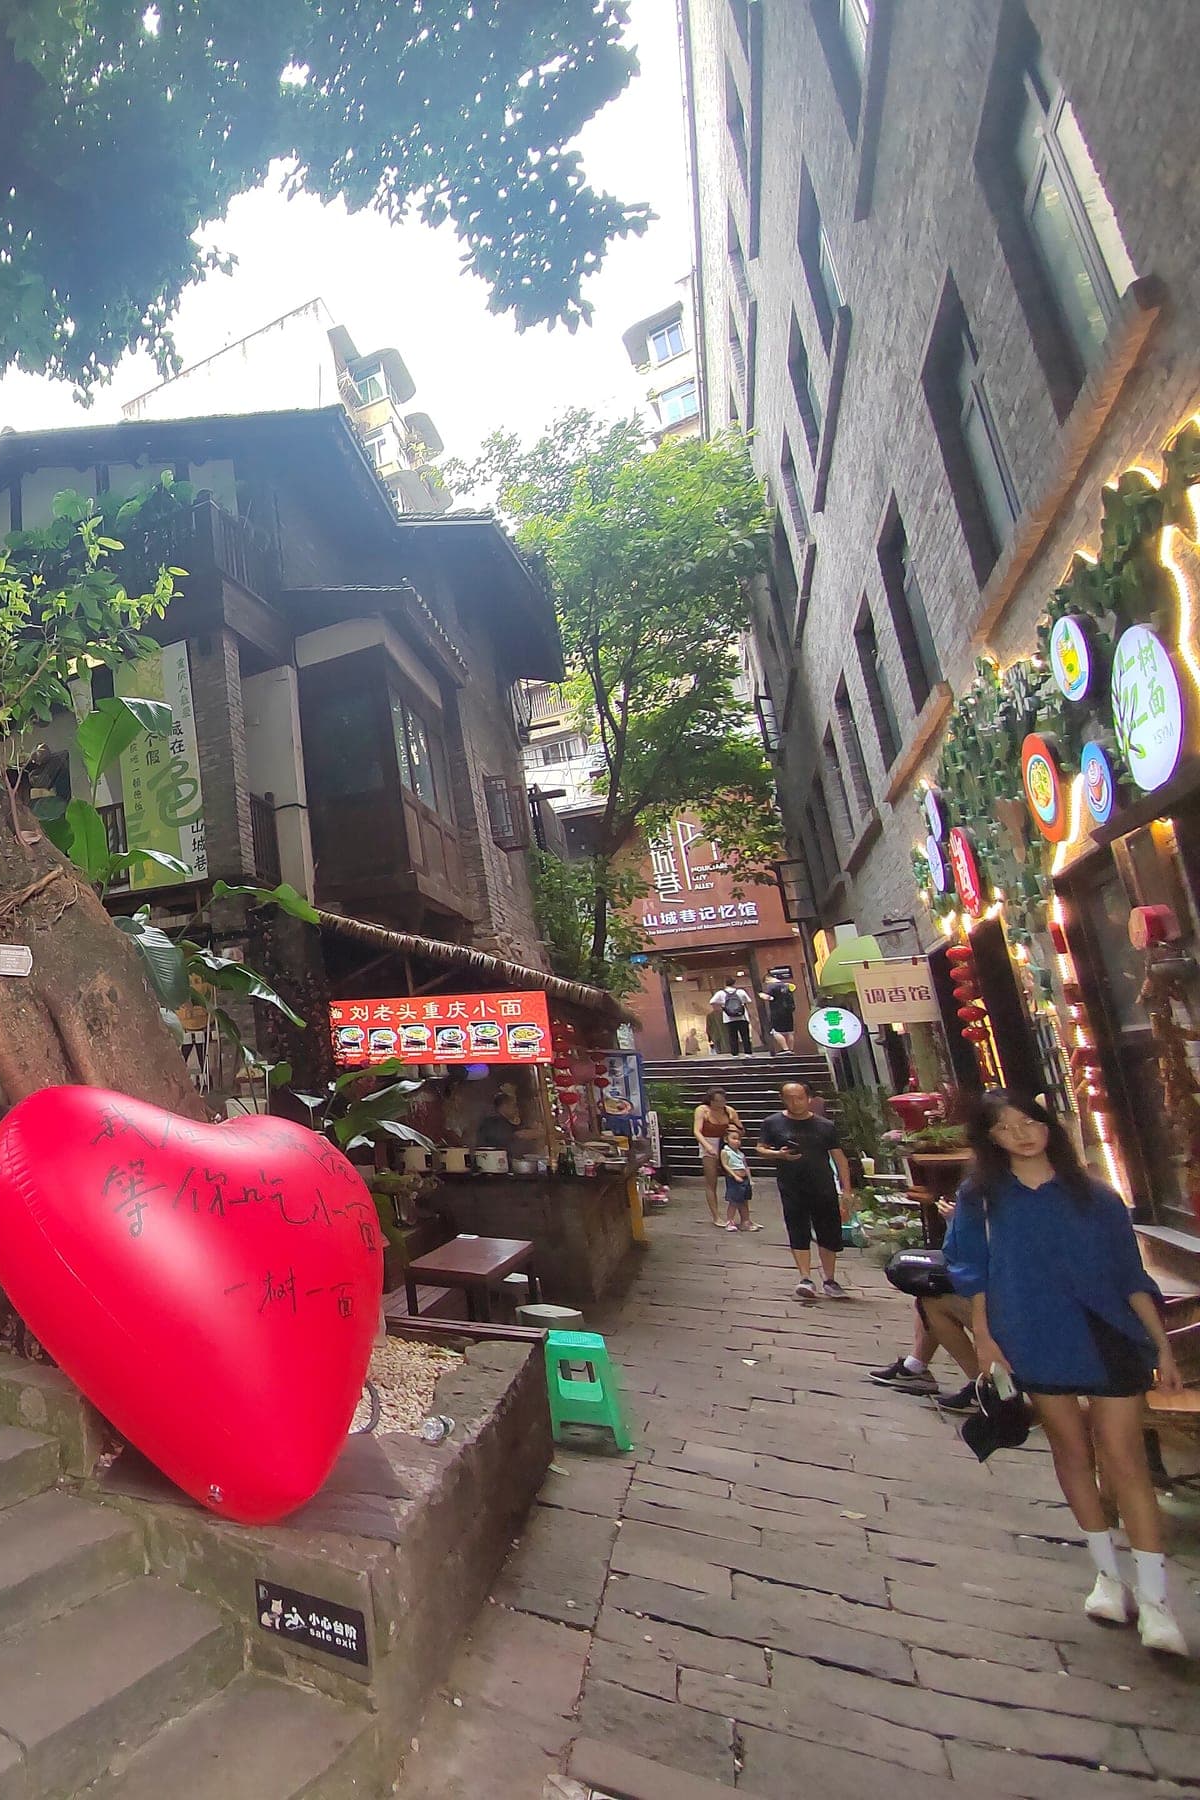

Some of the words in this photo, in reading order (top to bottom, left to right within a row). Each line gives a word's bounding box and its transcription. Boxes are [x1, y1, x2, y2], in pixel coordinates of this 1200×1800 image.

[694, 882, 714, 890] ALLEY
[642, 901, 758, 927] 山城巷记忆馆
[864, 984, 932, 1004] 调香馆
[349, 999, 522, 1022] 刘老头重庆小面
[101, 1159, 377, 1252] 等你吃小面
[224, 1267, 354, 1319] 一树一面
[308, 1612, 357, 1641] 小心台阶
[309, 1628, 332, 1642] safe
[335, 1636, 357, 1651] exit
